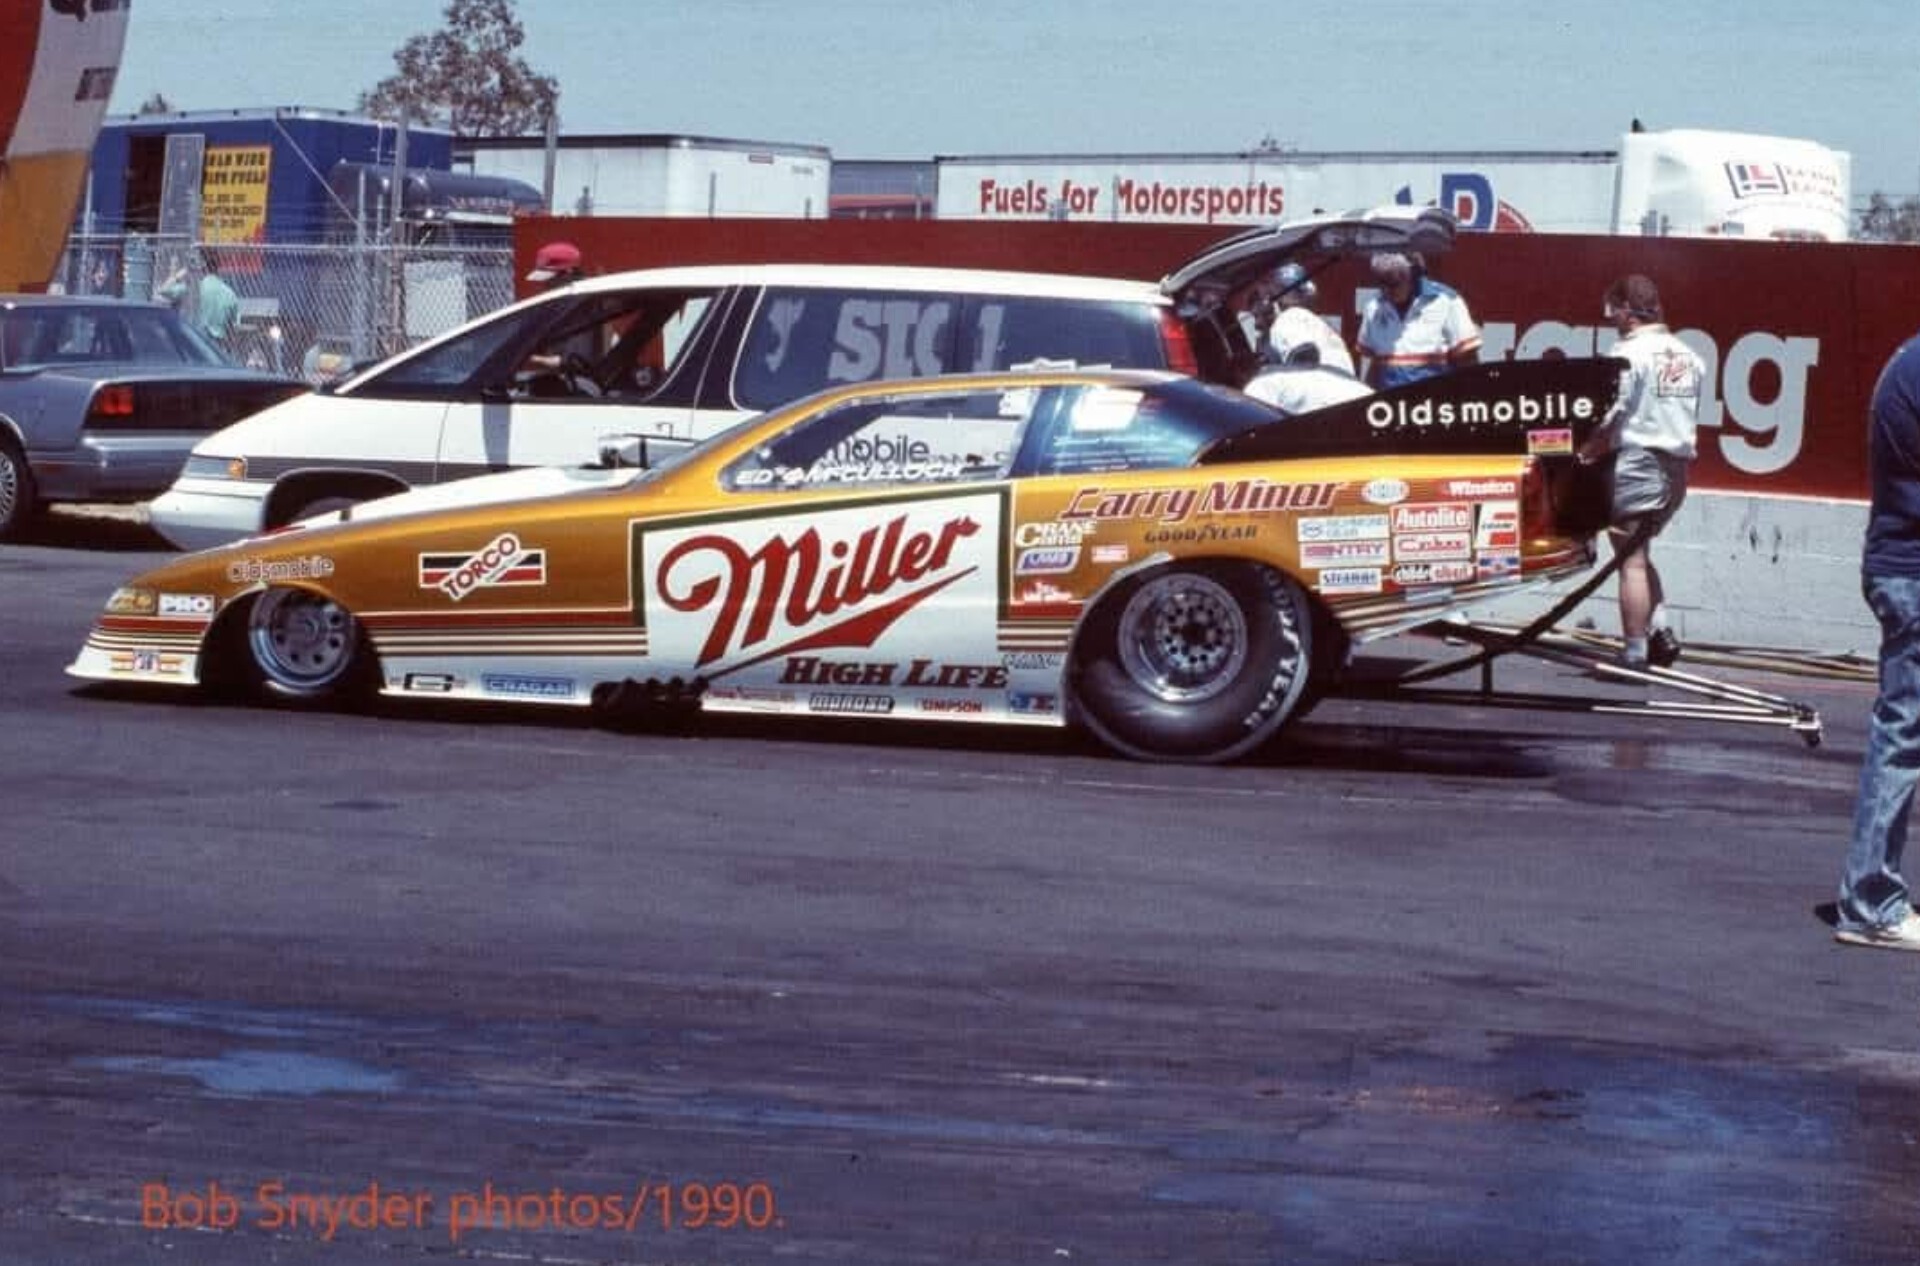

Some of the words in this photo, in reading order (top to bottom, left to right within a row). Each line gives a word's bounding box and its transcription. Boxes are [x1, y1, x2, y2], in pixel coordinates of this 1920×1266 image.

[980, 179, 1048, 213] Fuels
[1061, 179, 1100, 213] for
[1116, 178, 1284, 224] Motorsports
[1366, 392, 1594, 428] Oldsmobile
[1060, 486, 1198, 525] Larry
[1200, 480, 1344, 514] Minor
[1448, 480, 1515, 497] Winston
[1396, 507, 1468, 530] Autolite
[229, 555, 335, 583] Oldsmobile
[443, 537, 517, 598] TORCO
[162, 595, 211, 613] PRO
[657, 513, 982, 670] Miller
[778, 656, 899, 685] HIGH
[903, 659, 1010, 688] LIFE
[489, 680, 569, 695] CRAGAR
[921, 696, 983, 713] SIMPSON
